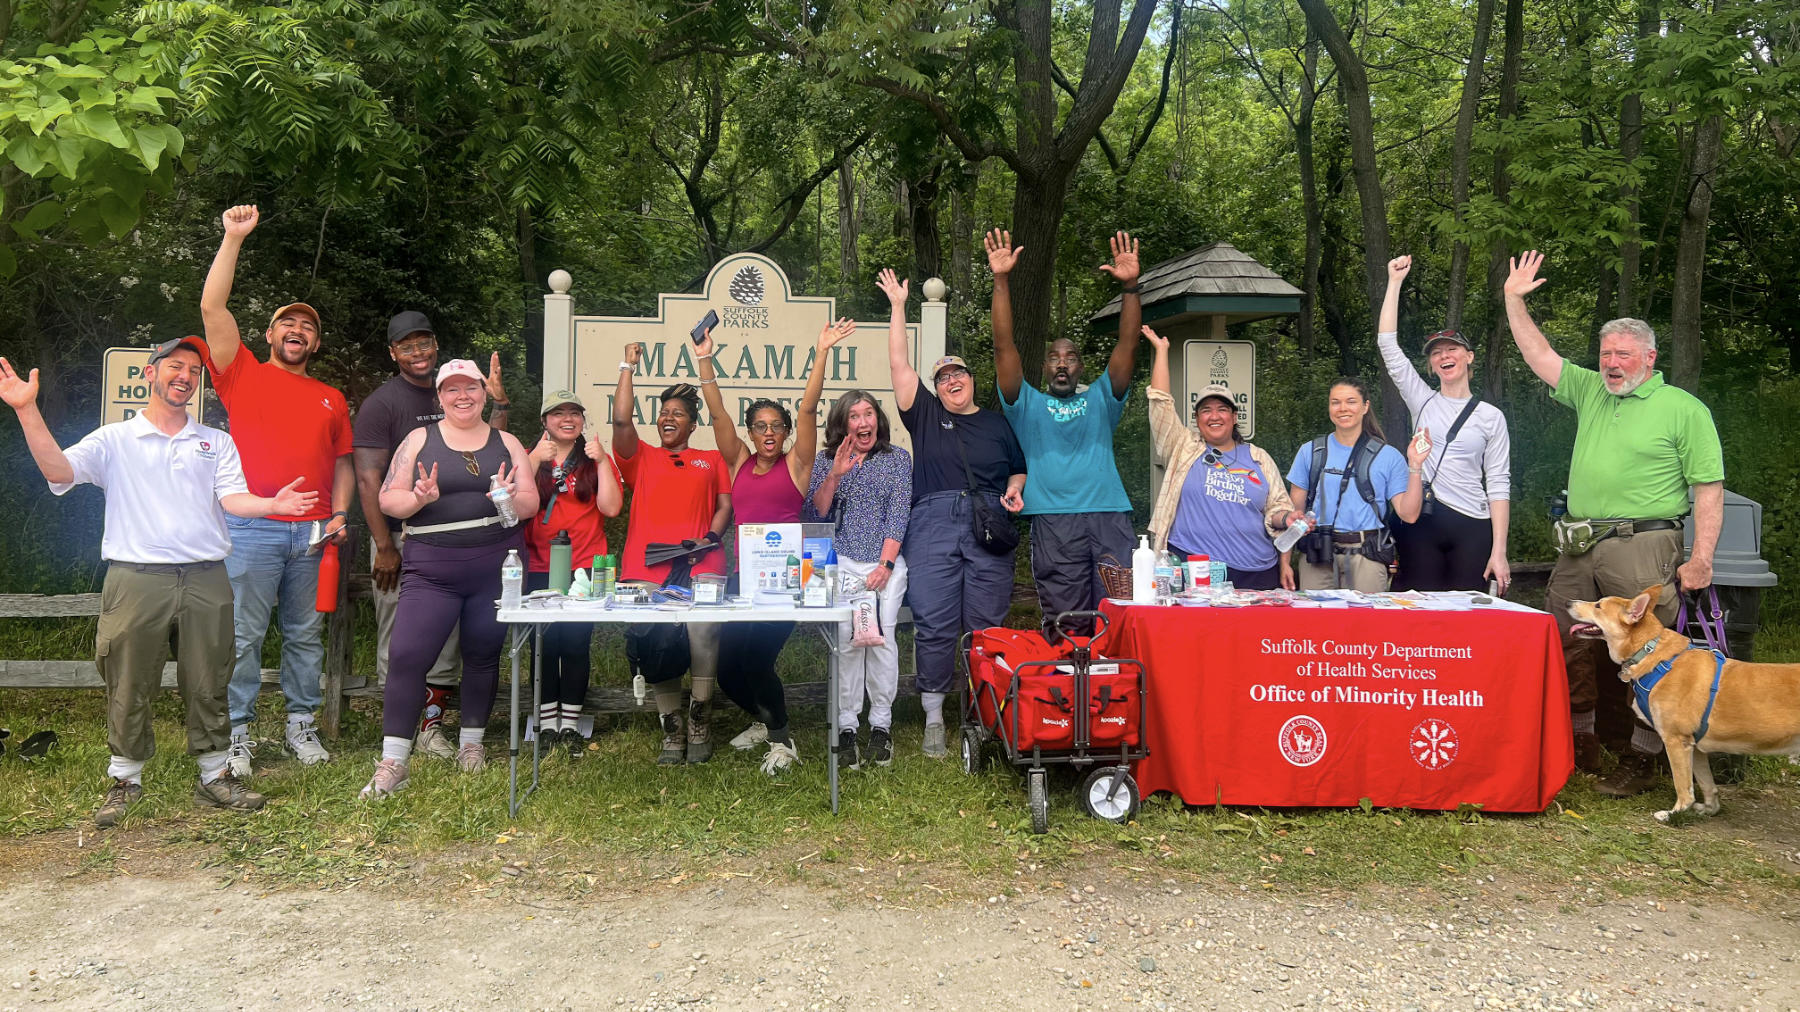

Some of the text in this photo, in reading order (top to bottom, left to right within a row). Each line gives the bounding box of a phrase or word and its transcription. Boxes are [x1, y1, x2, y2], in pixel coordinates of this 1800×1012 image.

[723, 319, 769, 328] PARKS
[634, 341, 858, 380] MAKAMAH
[1205, 475, 1245, 496] Birding
[1205, 484, 1251, 505] Together
[860, 601, 872, 632] Classic
[1261, 638, 1472, 661] Suffolk County Department
[1296, 661, 1437, 680] of Health Services
[1249, 684, 1484, 710] Office of Minority Health
